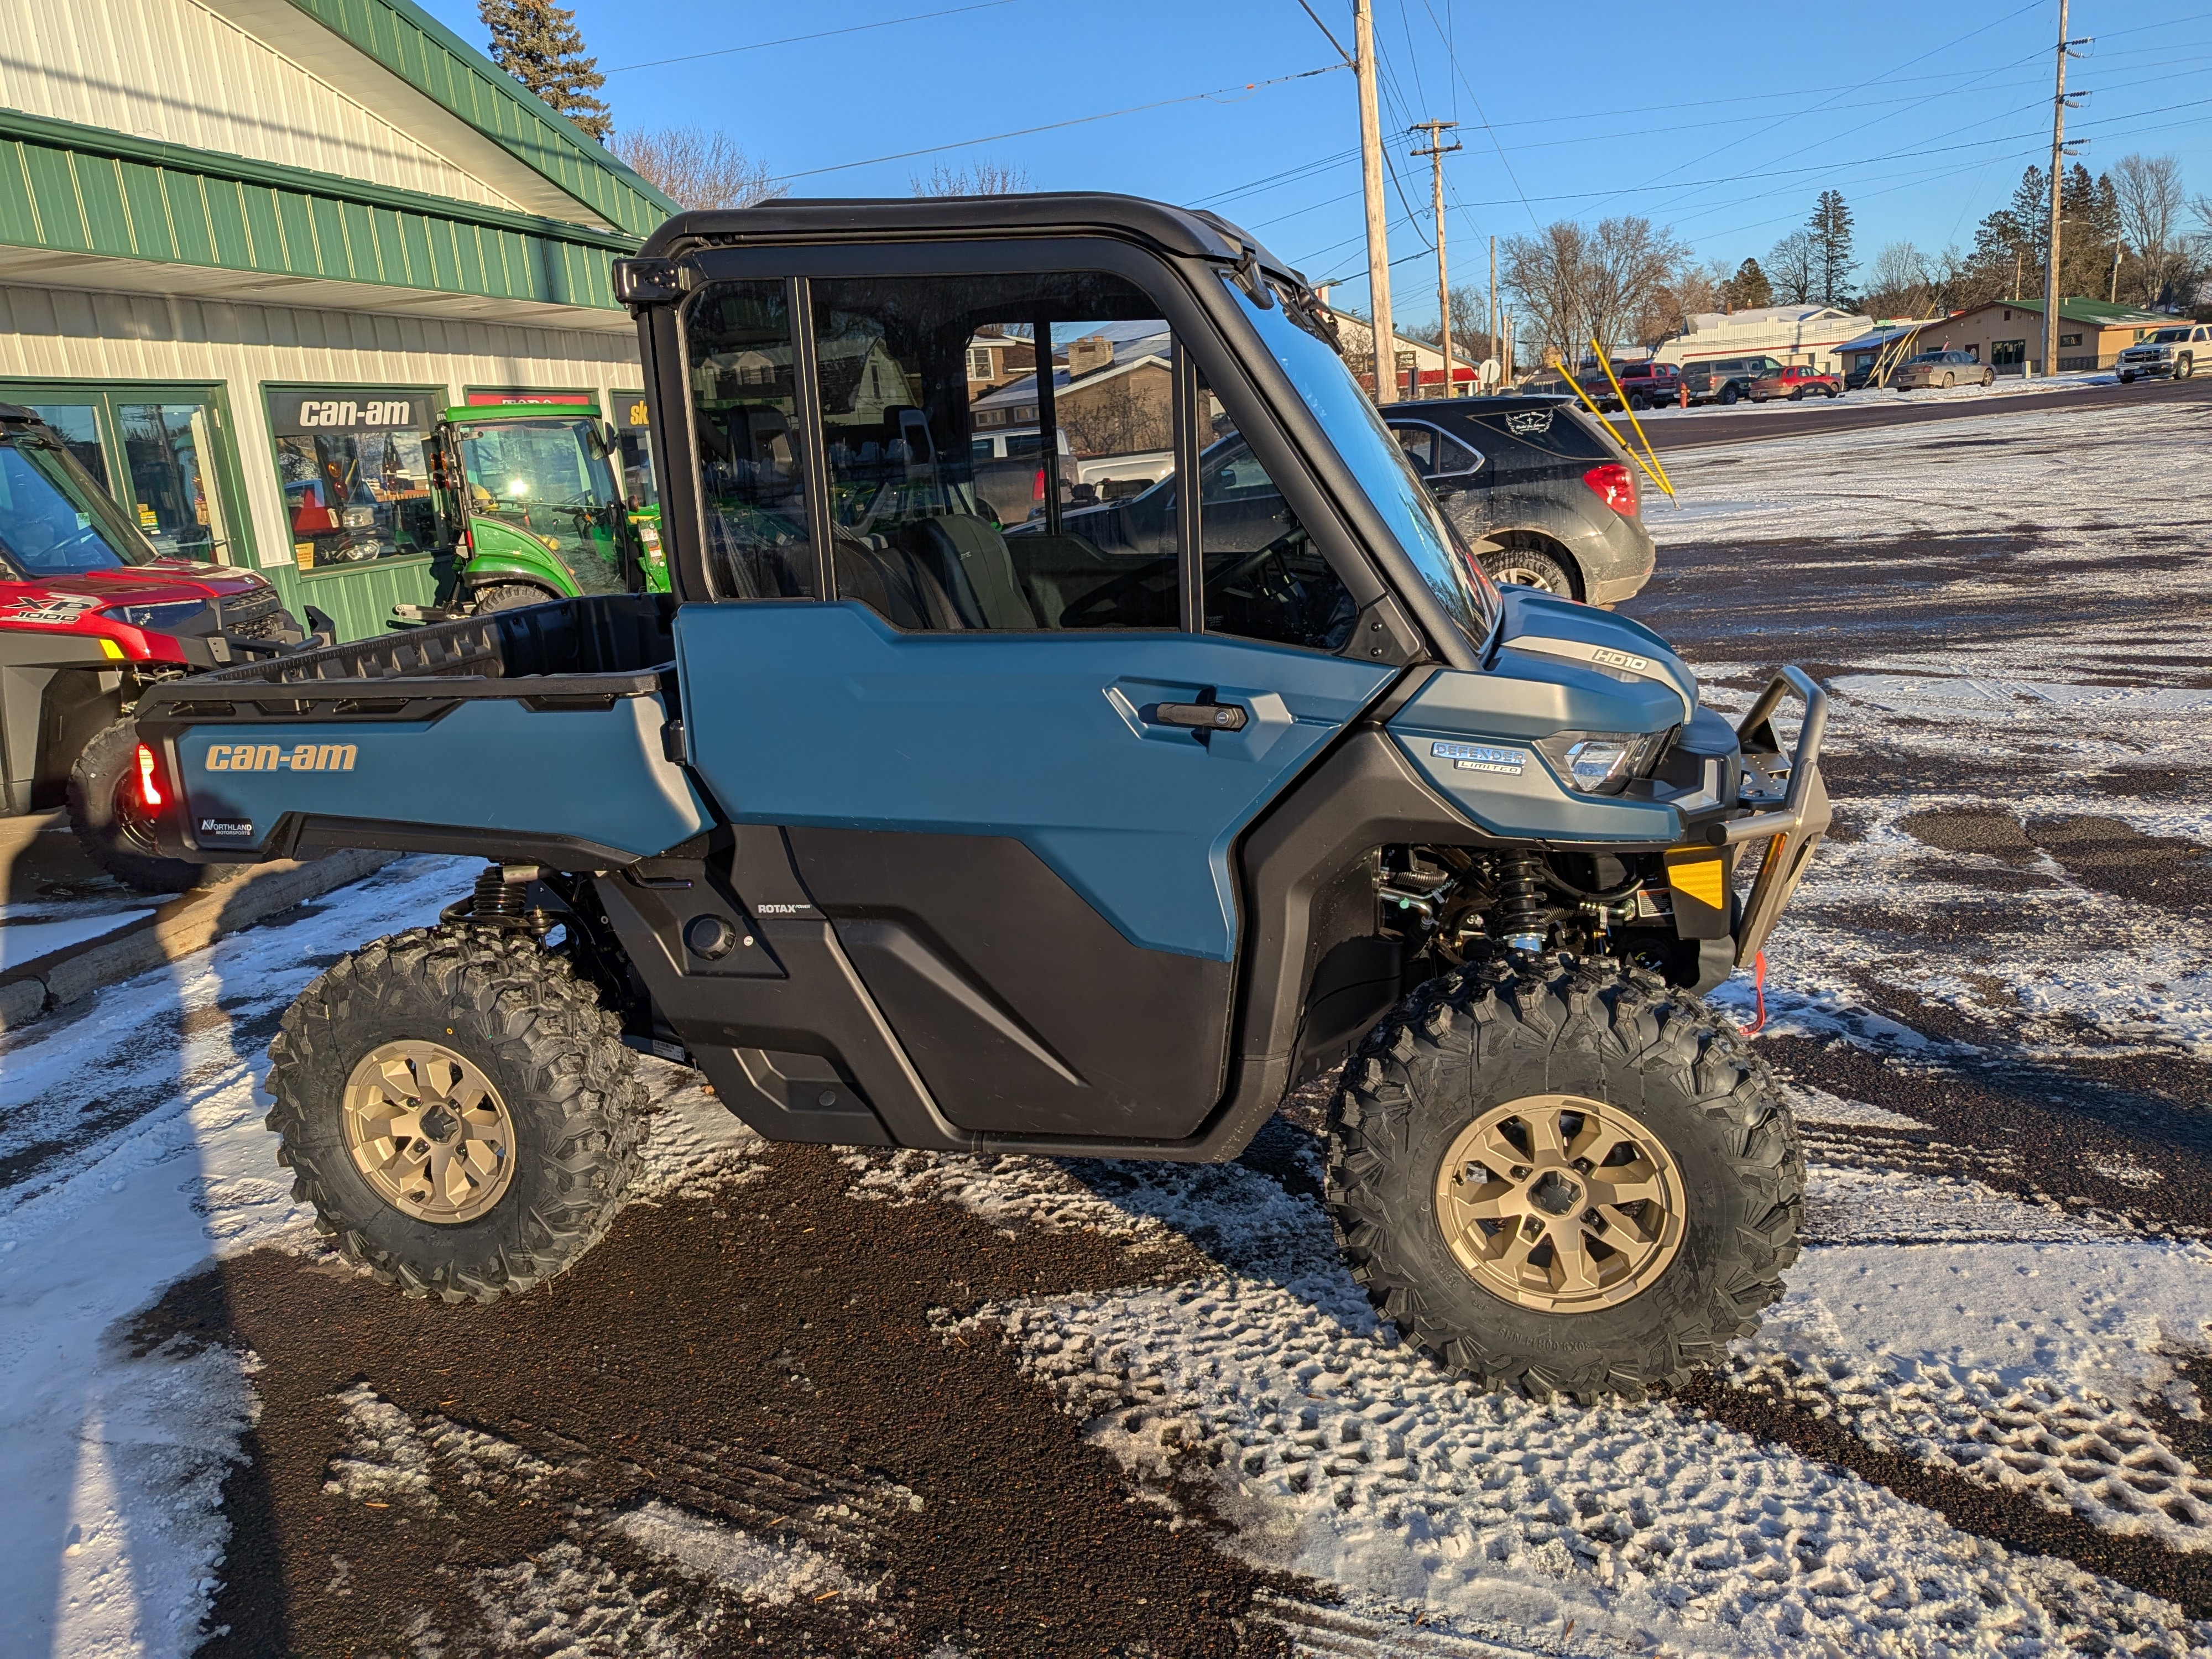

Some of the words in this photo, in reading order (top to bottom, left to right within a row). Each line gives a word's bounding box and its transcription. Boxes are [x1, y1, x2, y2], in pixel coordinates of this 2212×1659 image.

[300, 401, 410, 426] can-am
[630, 400, 649, 425] sk
[1, 596, 94, 611] XP
[18, 611, 81, 623] 1000
[1594, 650, 1647, 670] HD10
[205, 744, 358, 770] can-am
[1436, 744, 1525, 763] DEFENDER
[1460, 761, 1519, 773] LIMITED
[201, 819, 252, 831] NORTHLAND
[758, 904, 796, 913] ROTAX
